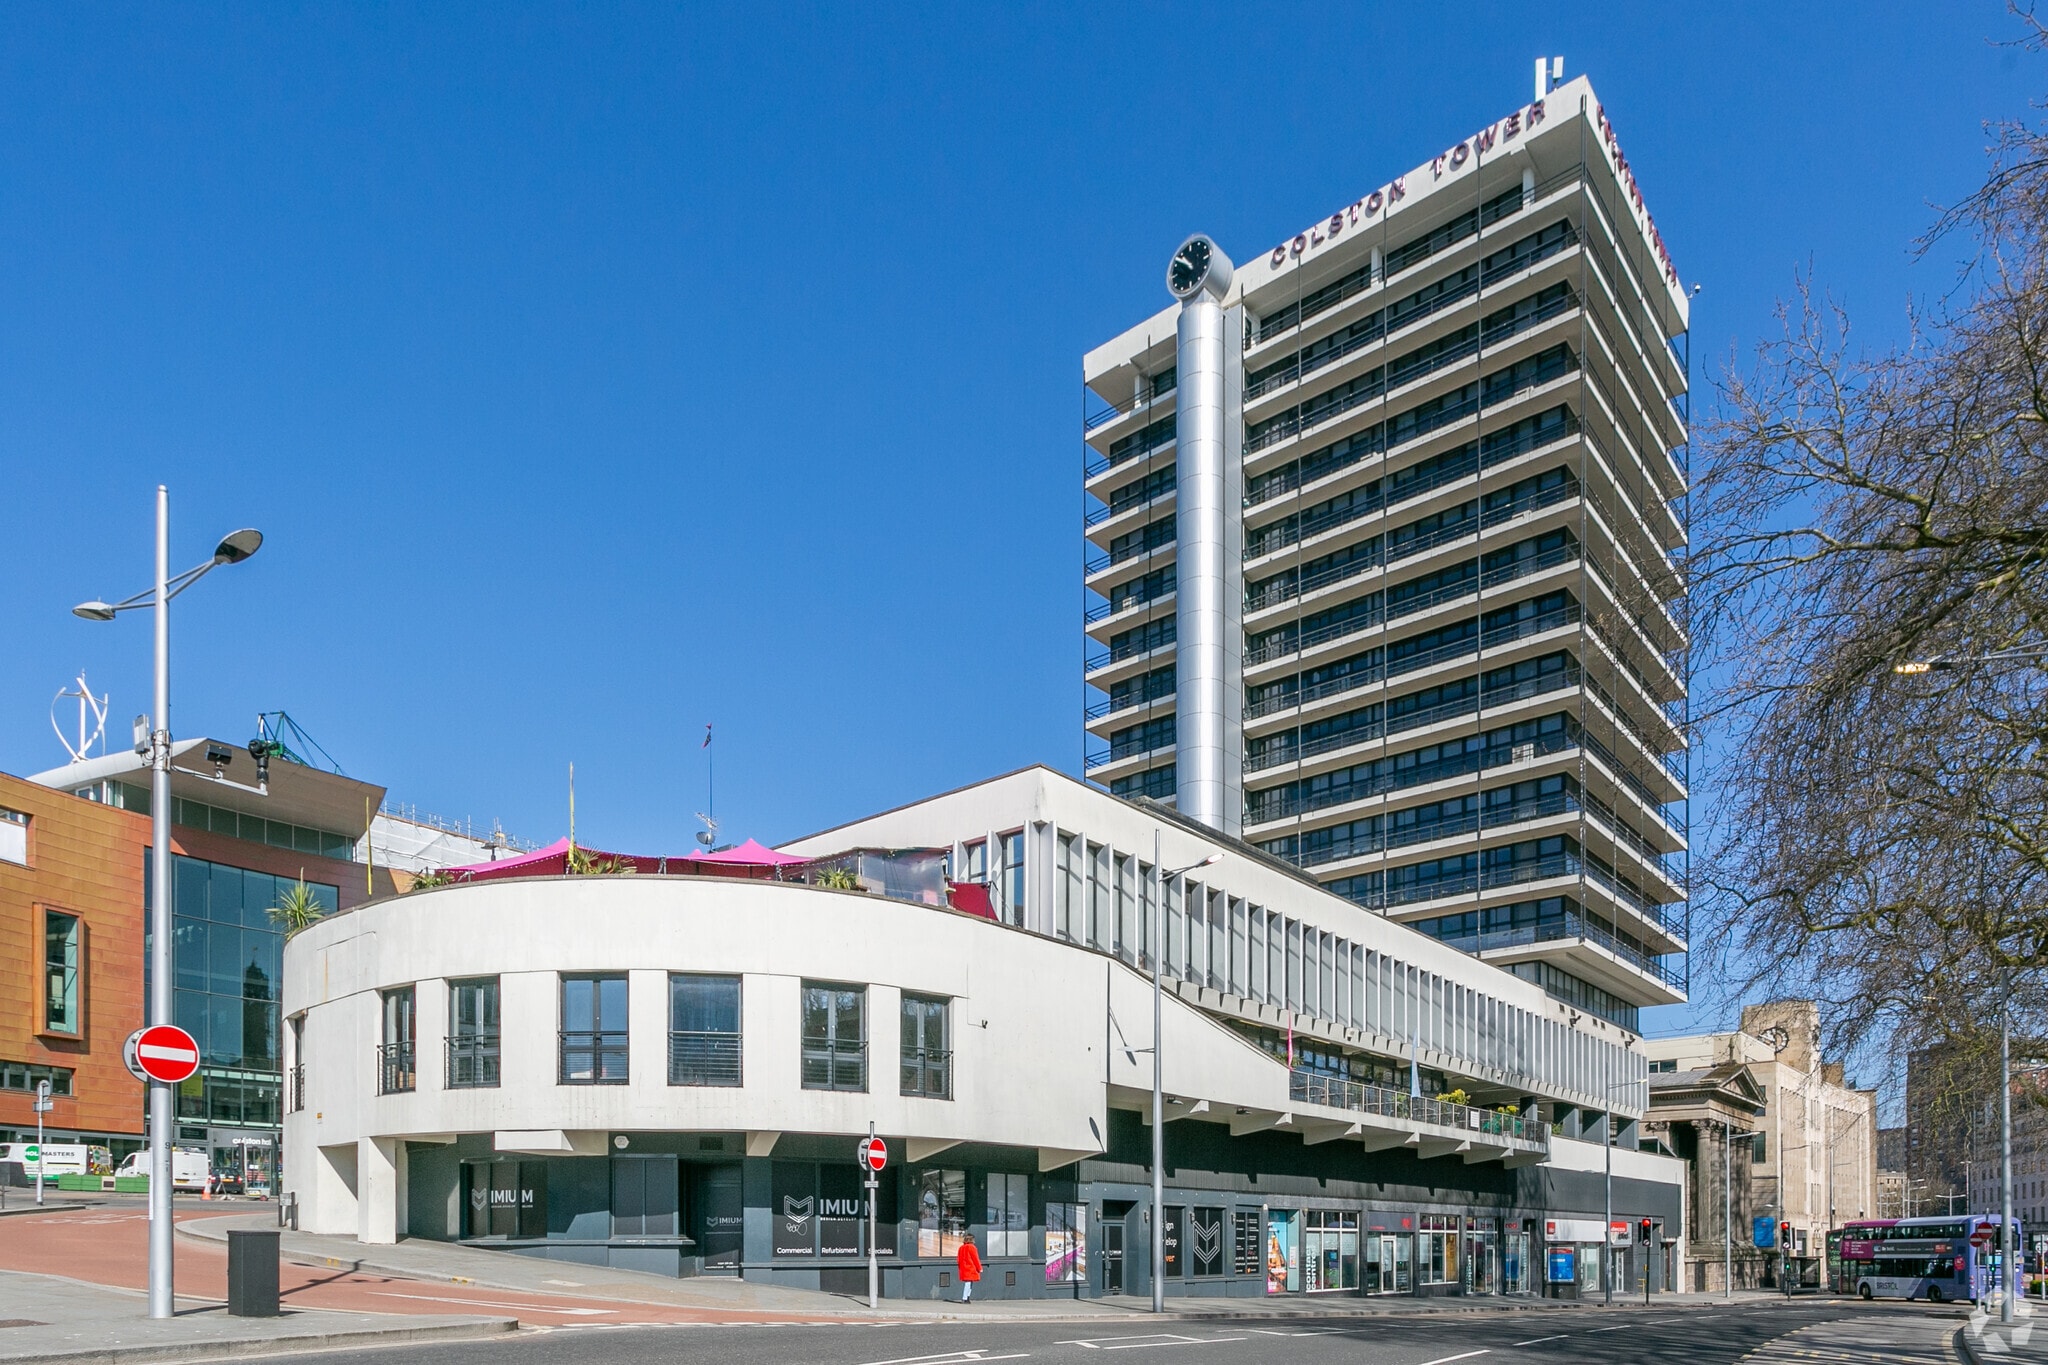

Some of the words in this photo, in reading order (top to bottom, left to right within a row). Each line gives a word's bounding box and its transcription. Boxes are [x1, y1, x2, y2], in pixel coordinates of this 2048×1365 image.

[1272, 176, 1406, 265] COLSTON
[1433, 99, 1546, 175] TOWER
[491, 1189, 533, 1203] IMIUM
[1877, 1282, 1898, 1290] BRISTOL
